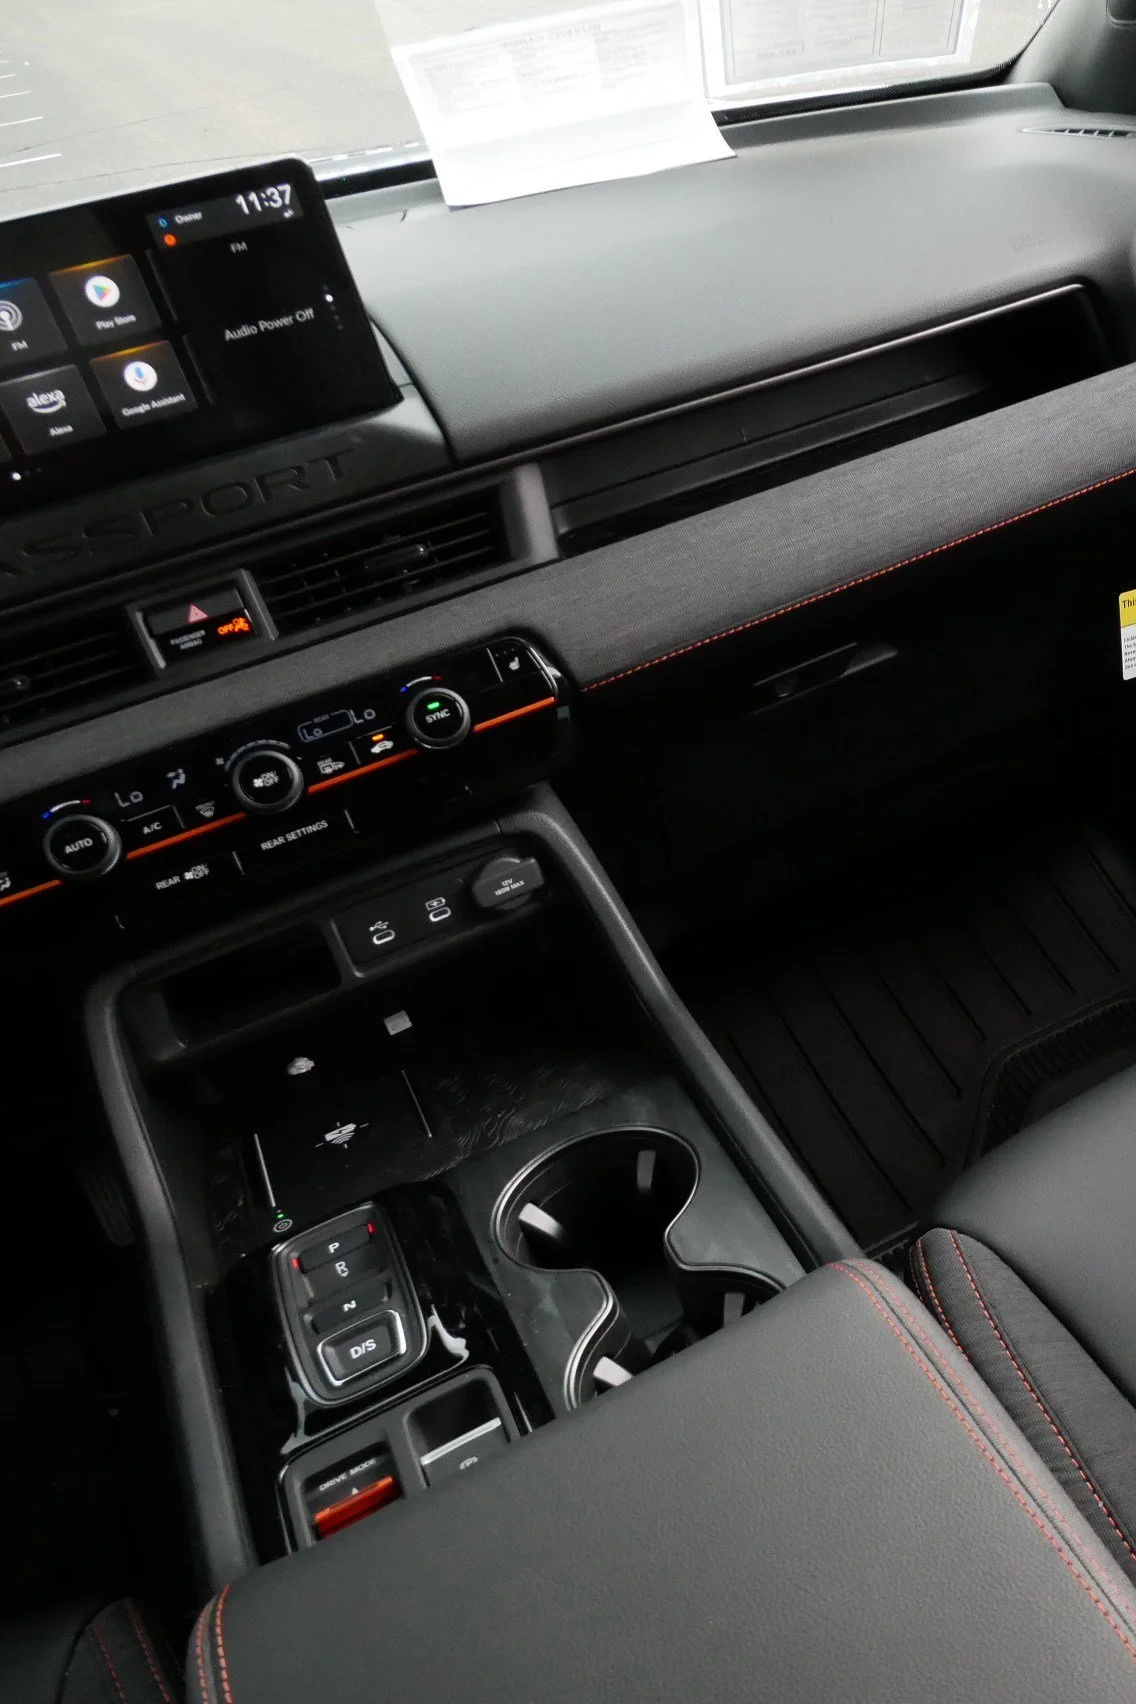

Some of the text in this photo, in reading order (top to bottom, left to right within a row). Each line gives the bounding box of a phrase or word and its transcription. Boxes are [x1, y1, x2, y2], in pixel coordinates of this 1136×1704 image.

[236, 183, 292, 214] 11:37
[174, 212, 202, 224] Owner
[230, 241, 248, 254] FM
[224, 308, 314, 341] Audio Power Off
[12, 340, 28, 351] FM
[26, 390, 66, 408] alexa
[122, 404, 151, 417] Google
[50, 425, 73, 436] Alexa
[217, 623, 234, 636] OFF
[426, 709, 450, 724] SYNC
[263, 776, 280, 786] OFF
[142, 822, 162, 834] A/C
[260, 820, 328, 850] REAR SETTINGS
[64, 838, 93, 854] AUTO
[193, 868, 210, 880] OFF
[156, 876, 181, 890] REAR
[510, 880, 524, 891] MAX
[328, 1242, 340, 1253] P
[335, 1261, 348, 1275] R
[343, 1300, 356, 1312] N
[350, 1338, 376, 1360] D/S
[320, 1458, 376, 1491] DRIVE MODE
